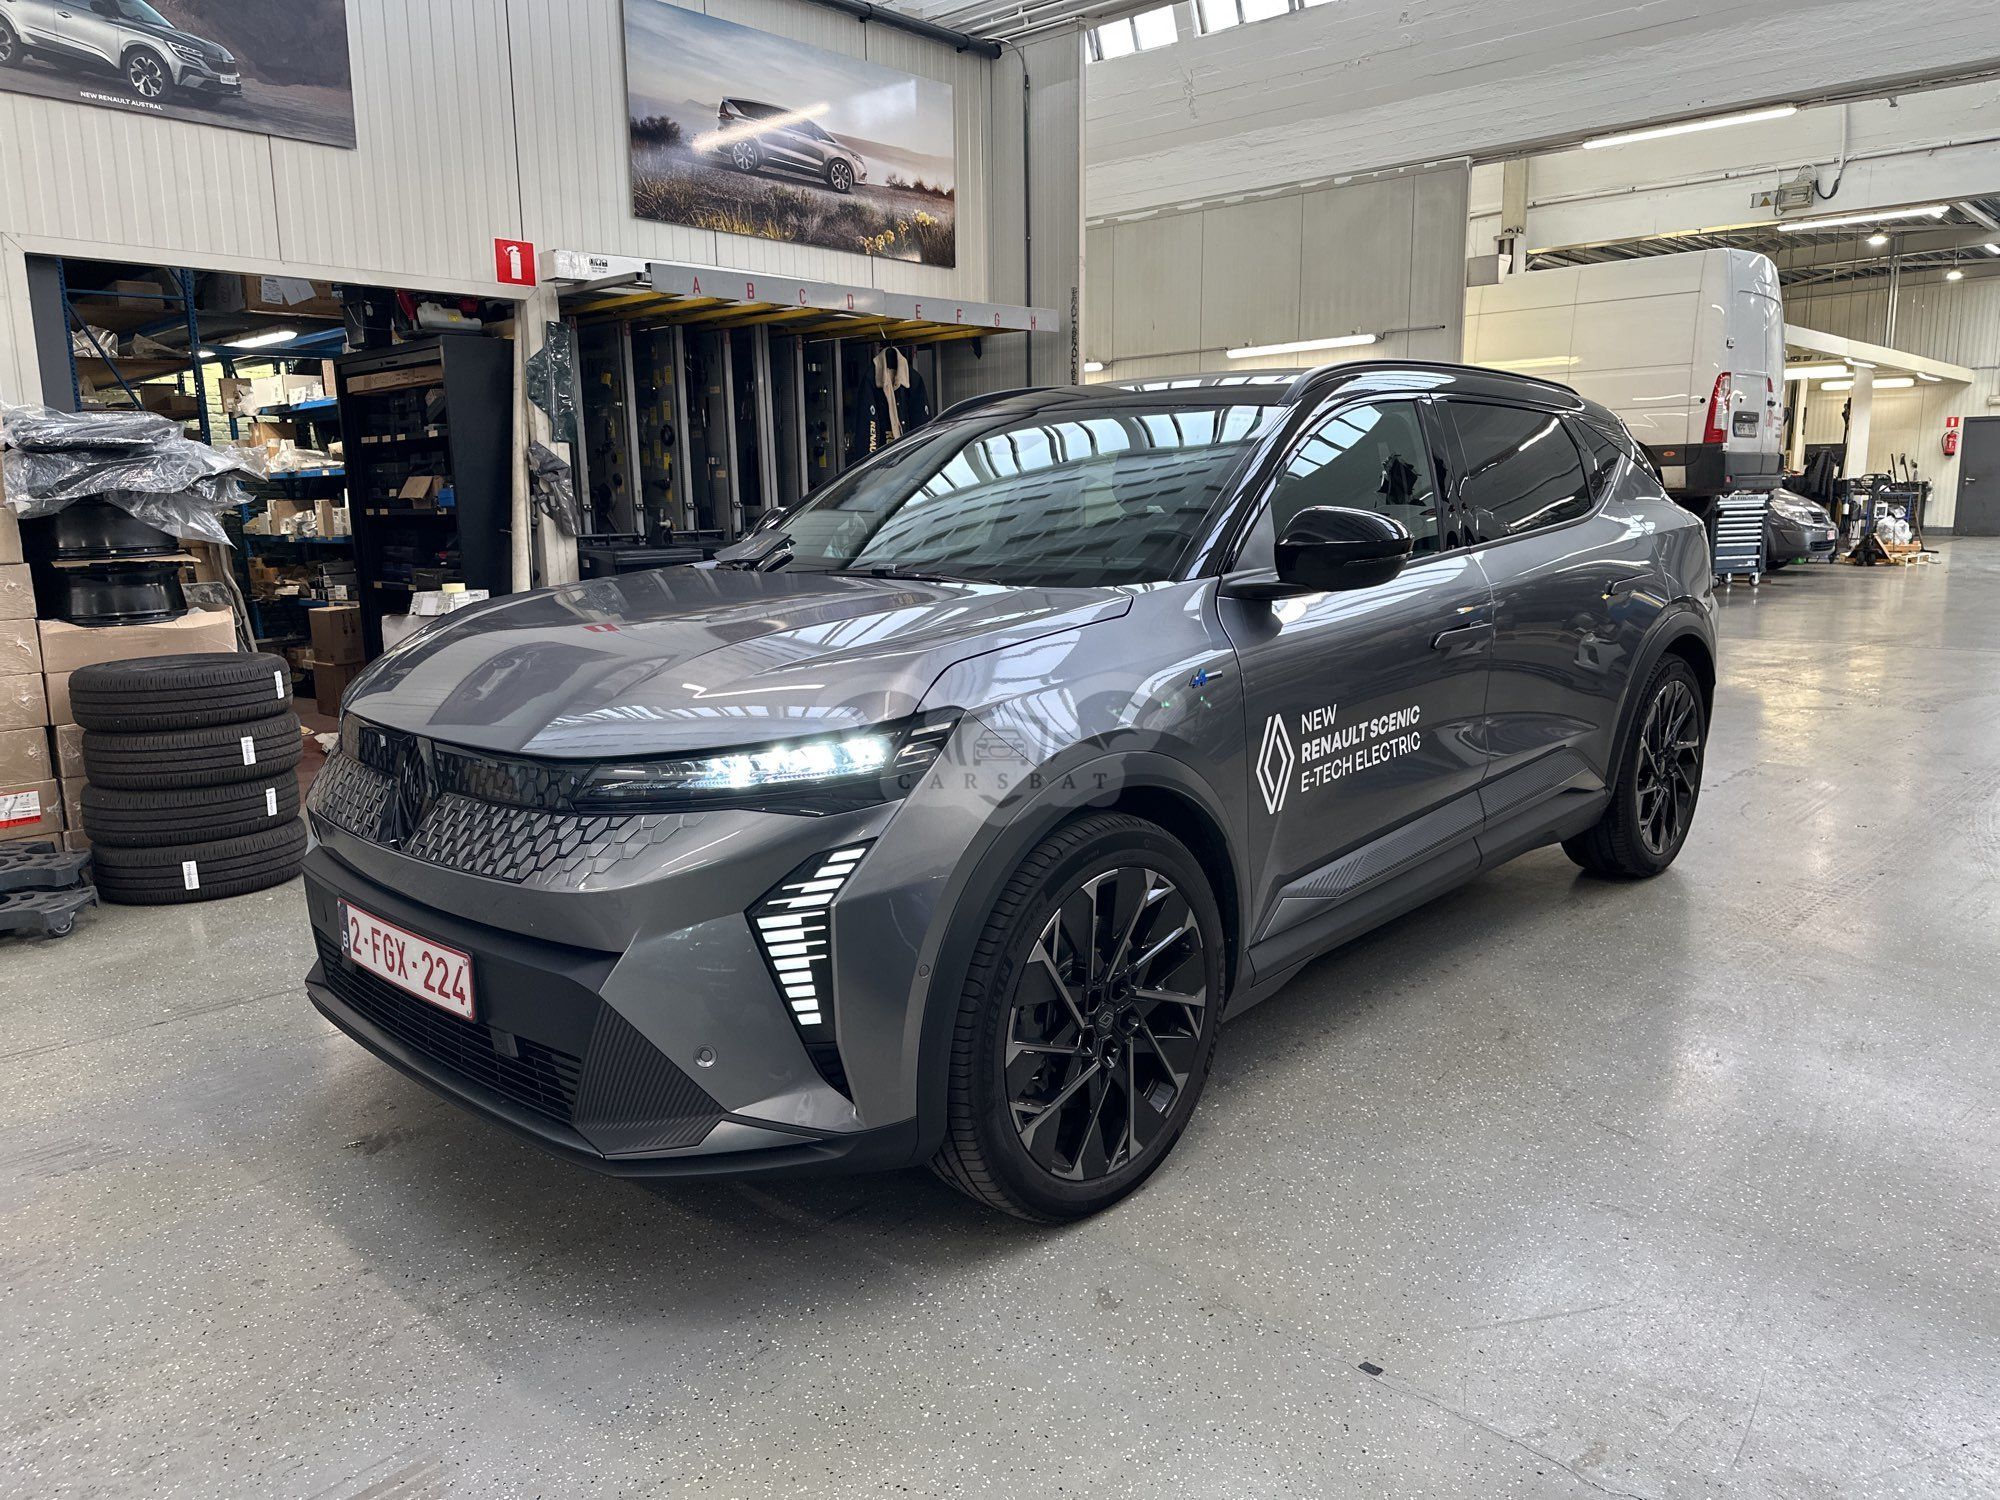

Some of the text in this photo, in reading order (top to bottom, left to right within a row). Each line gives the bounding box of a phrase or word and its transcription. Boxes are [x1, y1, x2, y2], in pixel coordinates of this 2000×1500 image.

[80, 91, 163, 111] NEW RENAULT AUSTRAL
[692, 276, 1036, 331] A B C D E F G H
[1301, 704, 1337, 734] NEW
[1301, 705, 1420, 764] RENAULT SCENIC
[1301, 731, 1421, 793] E-TECH ELECTRIC
